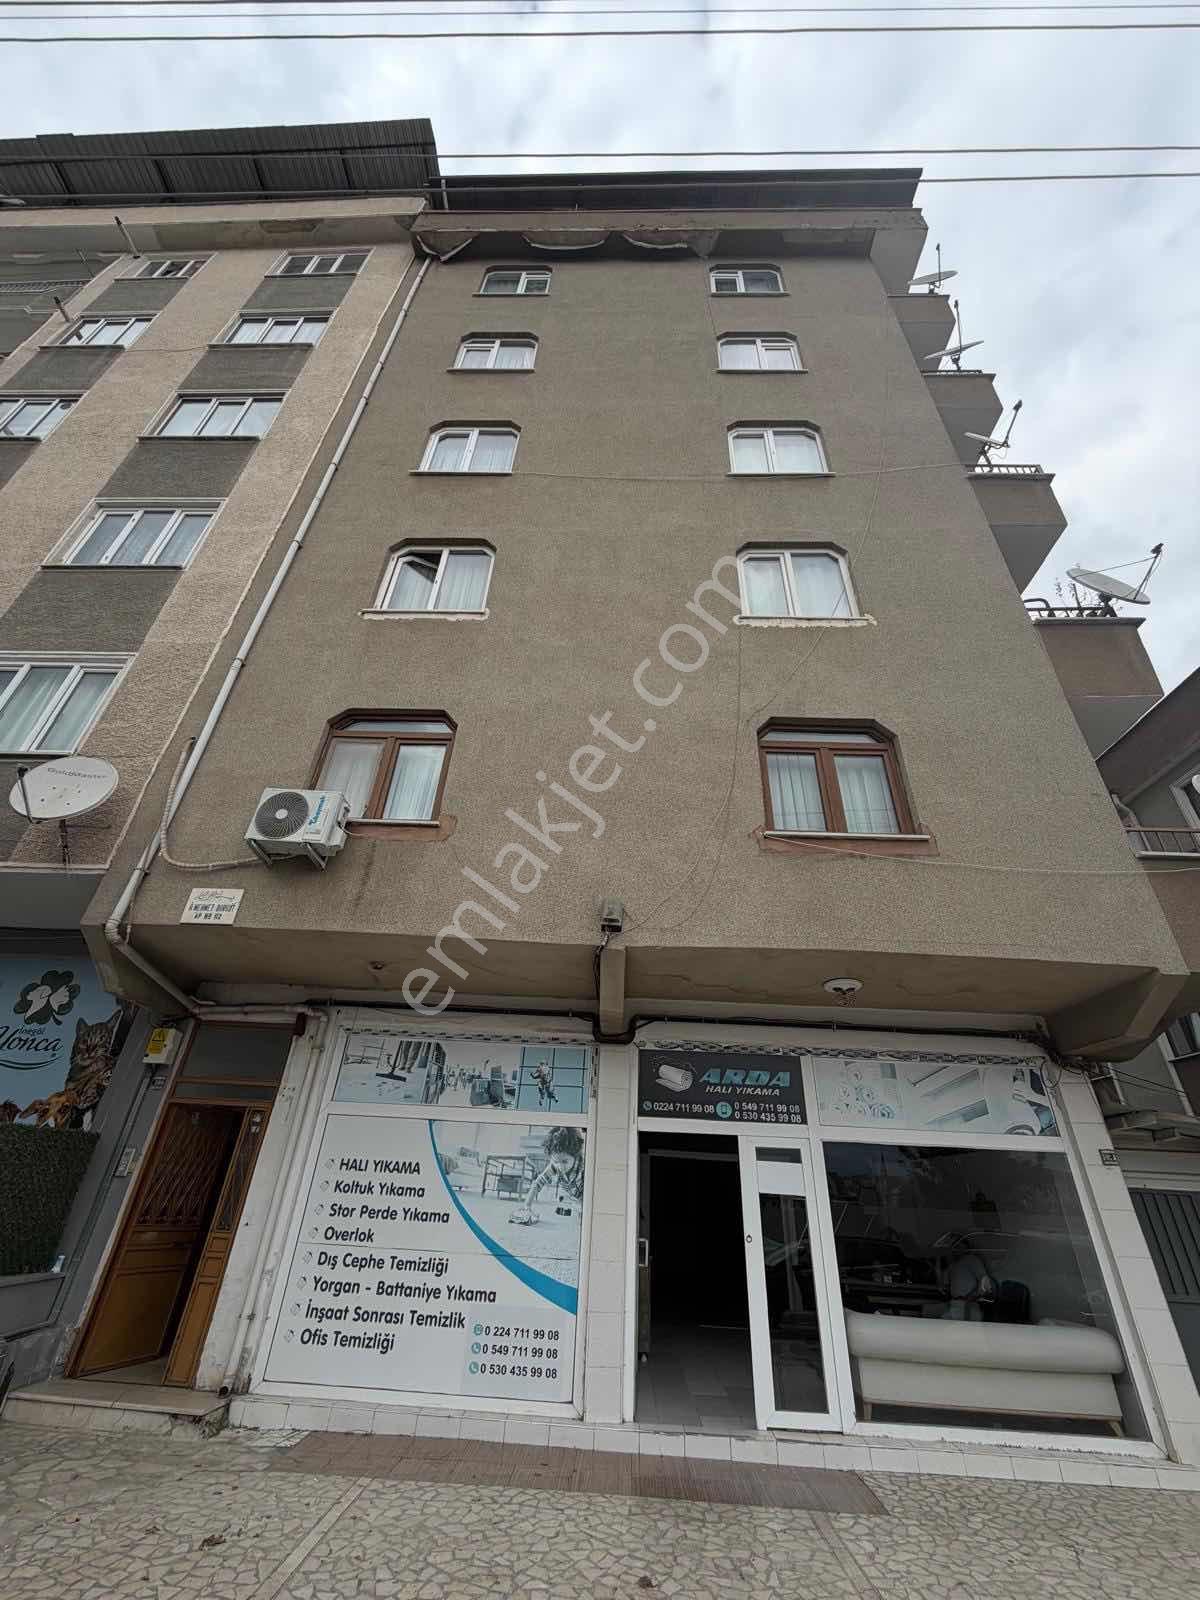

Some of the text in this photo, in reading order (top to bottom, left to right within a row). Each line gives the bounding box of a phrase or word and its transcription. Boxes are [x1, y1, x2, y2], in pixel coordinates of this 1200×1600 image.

[699, 1068, 791, 1089] ARDA
[705, 1085, 780, 1096] HALI YIKAMA
[654, 1102, 715, 1113] 0224 711 99 08
[734, 1102, 800, 1113] 0 549 711 99 08
[734, 1111, 801, 1123] 0 530 435 99 08
[339, 1158, 421, 1175] HALI YIKAMA
[334, 1180, 426, 1197] Koltuk Yıkama
[329, 1204, 450, 1223] Stor Perde Yıkama
[324, 1226, 374, 1242] Overlok
[318, 1251, 449, 1277] Dış Cephe Temizliği
[313, 1275, 361, 1297] Yorgan
[376, 1280, 441, 1302] Battaniye
[446, 1284, 497, 1304] Yıkama
[305, 1298, 466, 1329] İnşaat Sonrası Temizlik
[485, 1325, 560, 1341] 0 224 711 99 08
[300, 1328, 395, 1355] Ofis Temizliği
[482, 1343, 558, 1359] 0 549 711 99 08
[480, 1363, 558, 1379] 0 530 435 99 08
